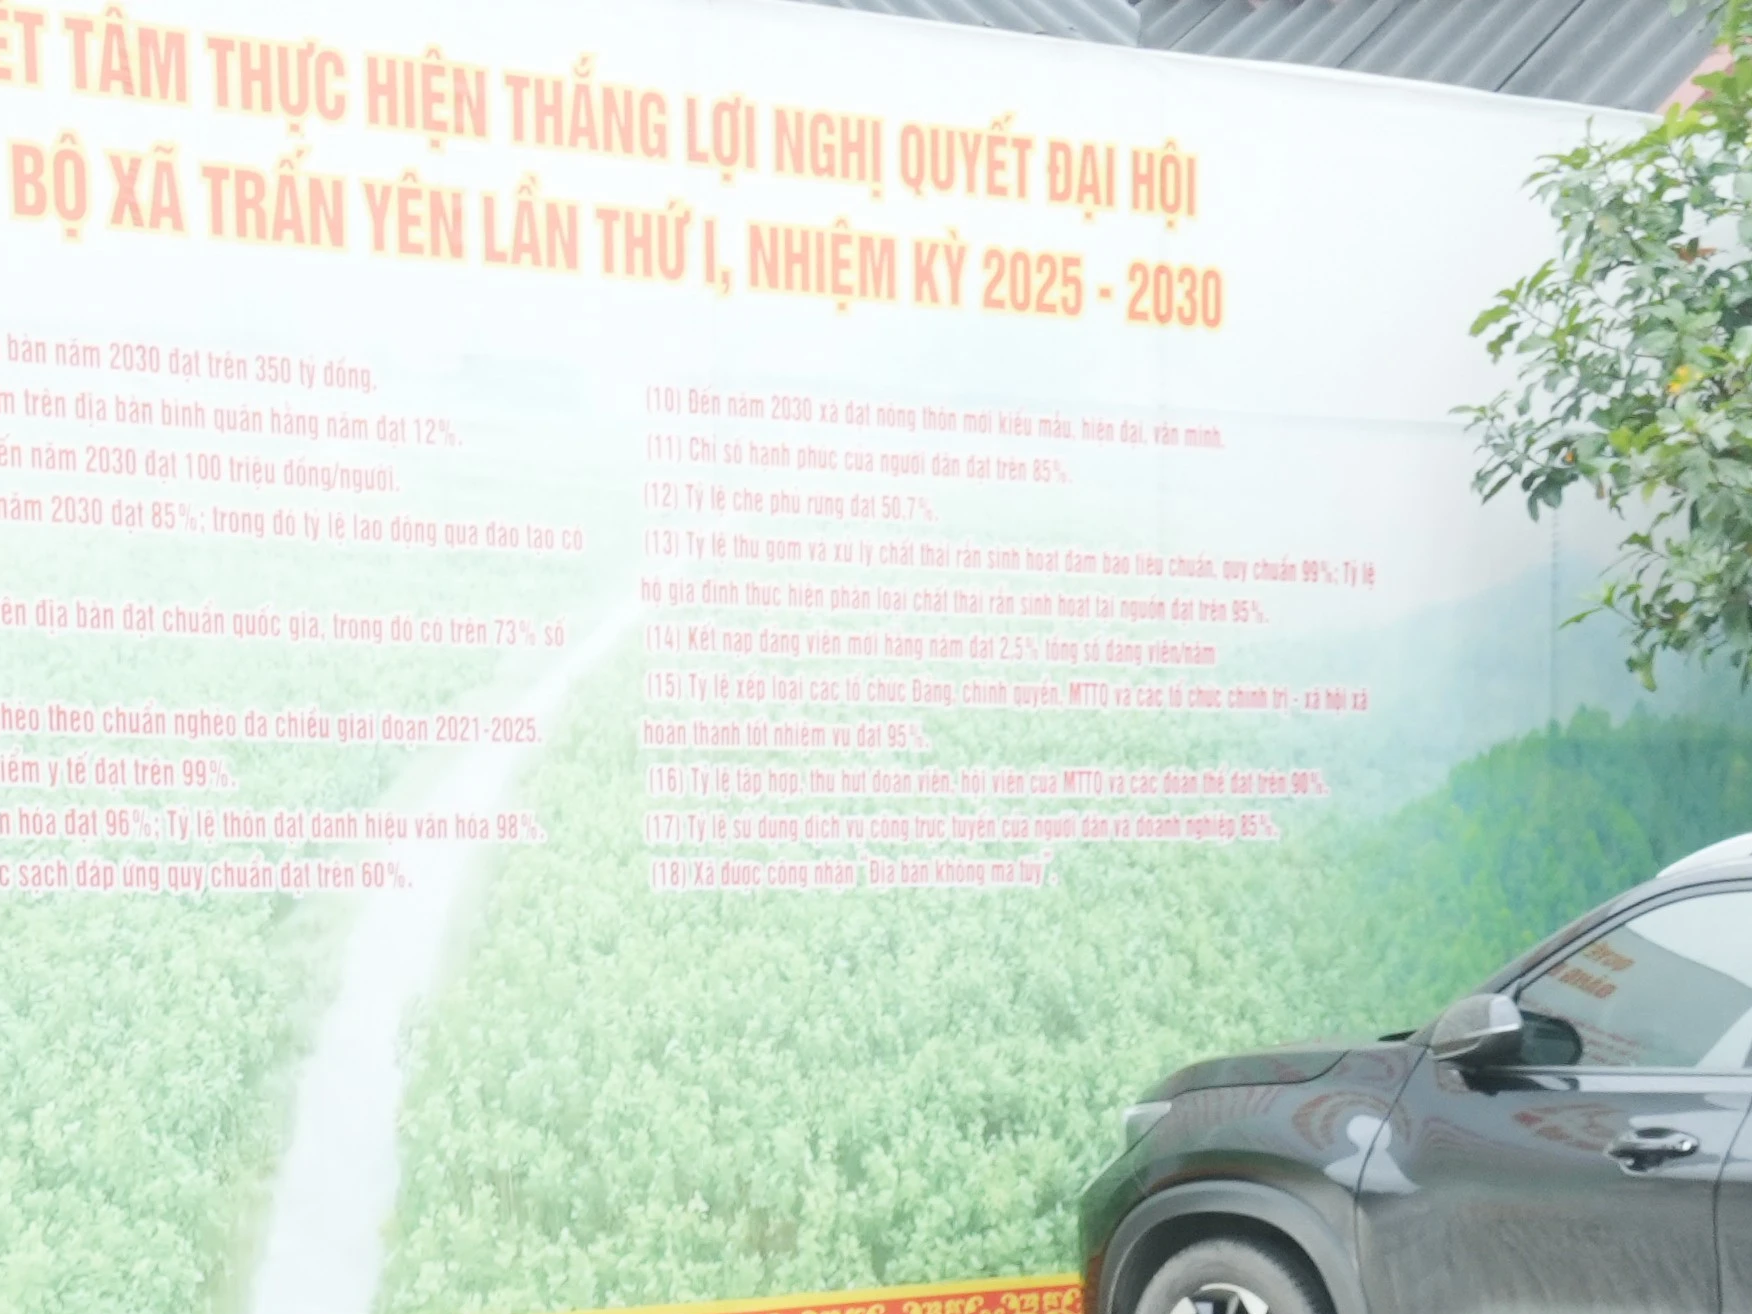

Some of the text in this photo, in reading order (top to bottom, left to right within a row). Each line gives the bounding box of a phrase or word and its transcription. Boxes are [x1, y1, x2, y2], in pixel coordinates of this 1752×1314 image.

[60, 3, 192, 105] TÂM
[203, 32, 351, 135] THỰC
[363, 45, 492, 150] HIỆN
[502, 54, 673, 161] THẮNG
[681, 93, 761, 184] LỢI
[770, 105, 887, 200] NGHỊ
[896, 113, 1038, 202] QUYẾT
[1044, 137, 1120, 222] ĐẠI
[1127, 137, 1201, 230] HỘI
[8, 129, 91, 240] BỘ
[106, 142, 188, 234] XÃ
[199, 146, 349, 249] TRẤN
[361, 168, 468, 262] YÊN
[479, 174, 582, 273] LẦN
[592, 198, 695, 283] THỨ
[701, 216, 735, 294] I,
[745, 216, 901, 312] NHIỆM
[910, 228, 970, 307] KỲ
[979, 245, 1087, 319] 2025
[1124, 258, 1227, 331] 2030
[6, 333, 47, 363] bàn
[54, 338, 101, 368] năm
[109, 342, 161, 373] 2030
[168, 347, 200, 381] đạt
[22, 388, 67, 418] trên
[74, 392, 108, 426] địa
[113, 395, 154, 424] bàn
[160, 399, 206, 428] bình
[30, 443, 77, 470] năm
[85, 445, 137, 475] 2030
[144, 449, 177, 483] đạt
[185, 452, 222, 481] 100
[51, 495, 102, 525] 2030
[111, 499, 143, 533] đạt
[151, 502, 205, 534] 85%;
[47, 761, 59, 787] y
[66, 751, 87, 784] tế
[95, 757, 126, 790] đạt
[133, 758, 175, 786] trên
[182, 759, 235, 786] 99%.
